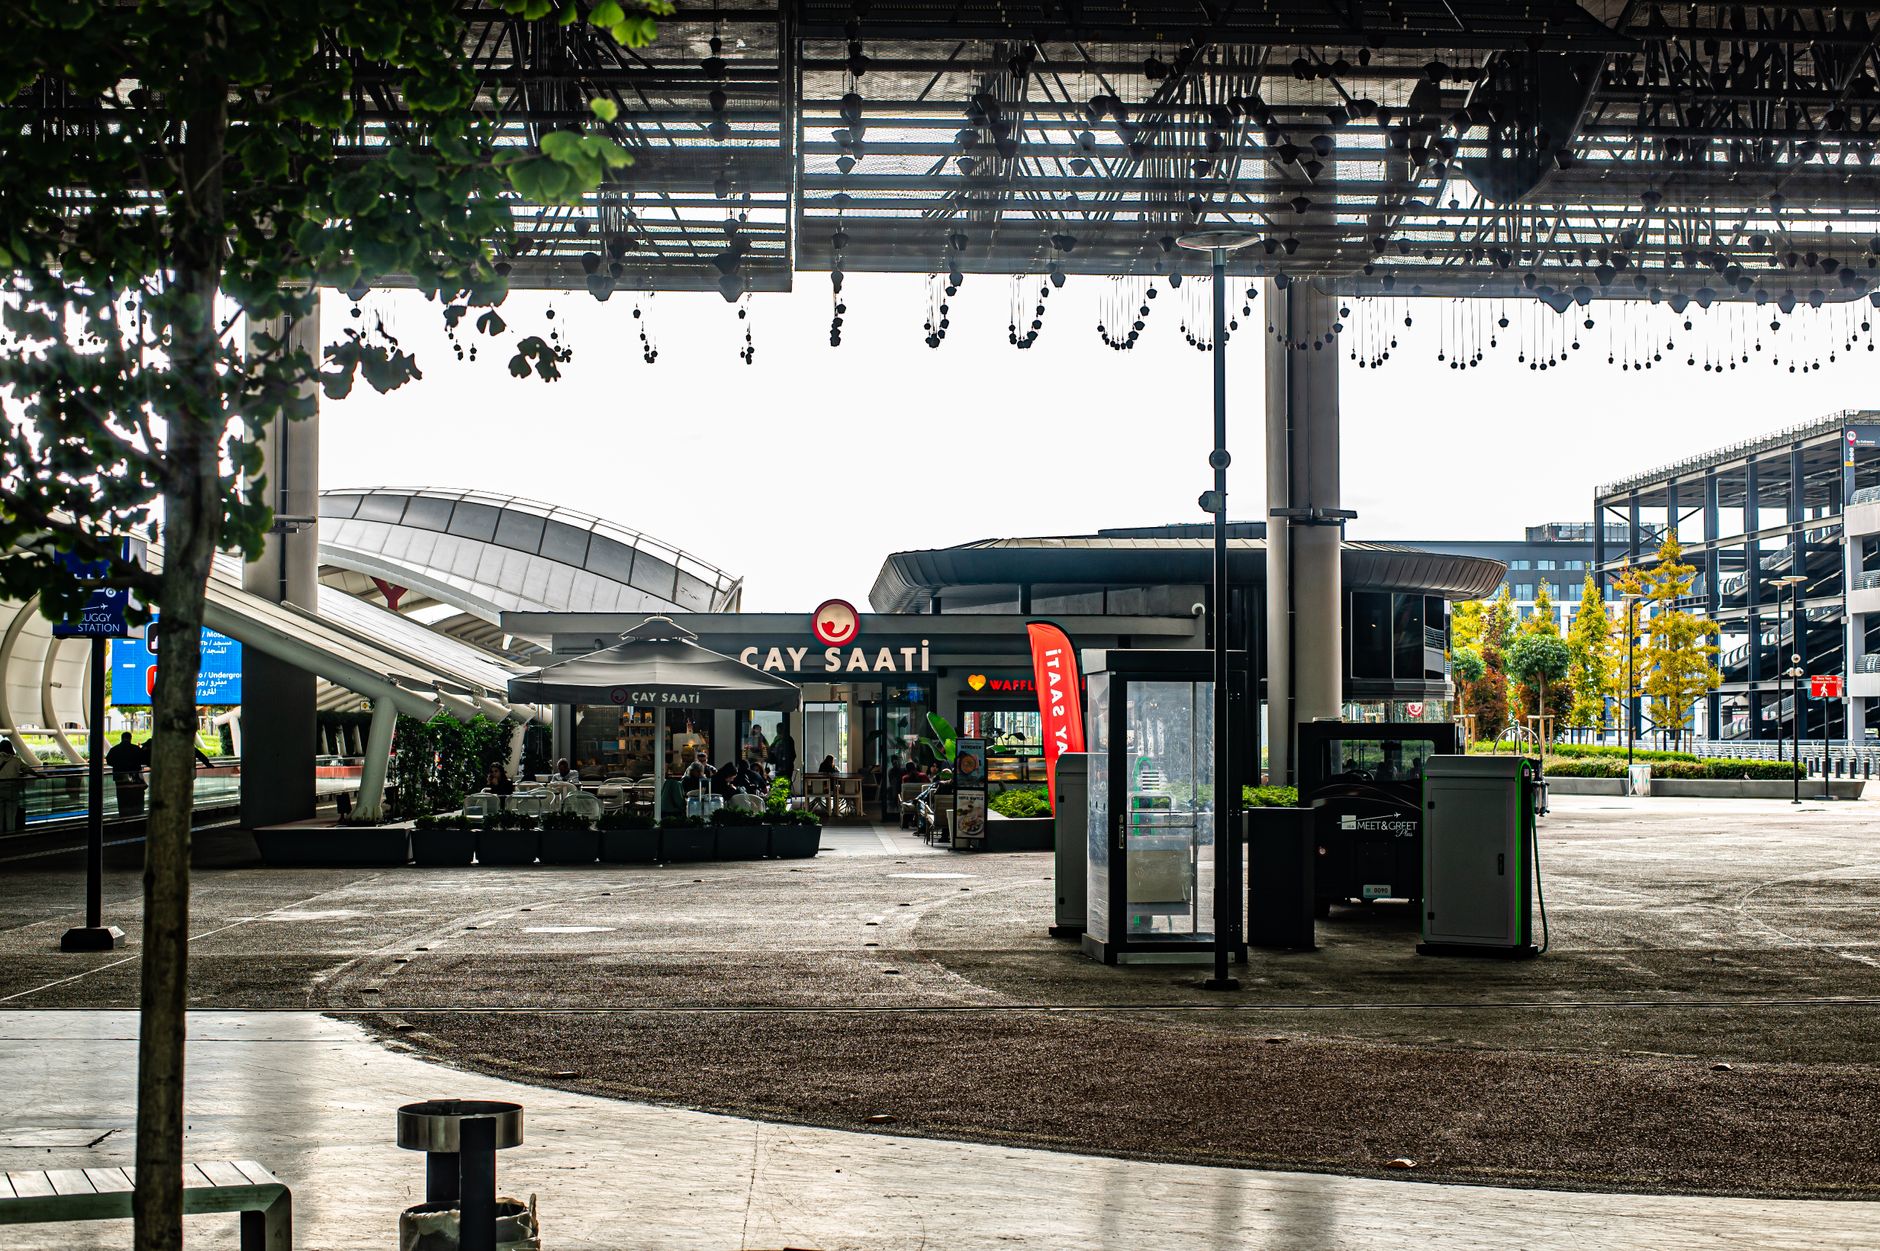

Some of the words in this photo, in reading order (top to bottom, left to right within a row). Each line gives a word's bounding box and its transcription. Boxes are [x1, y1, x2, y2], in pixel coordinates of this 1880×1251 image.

[81, 613, 111, 622] UGGY
[78, 624, 120, 632] STATION
[989, 680, 1037, 691] WAFFL
[631, 692, 657, 704] ÇAY
